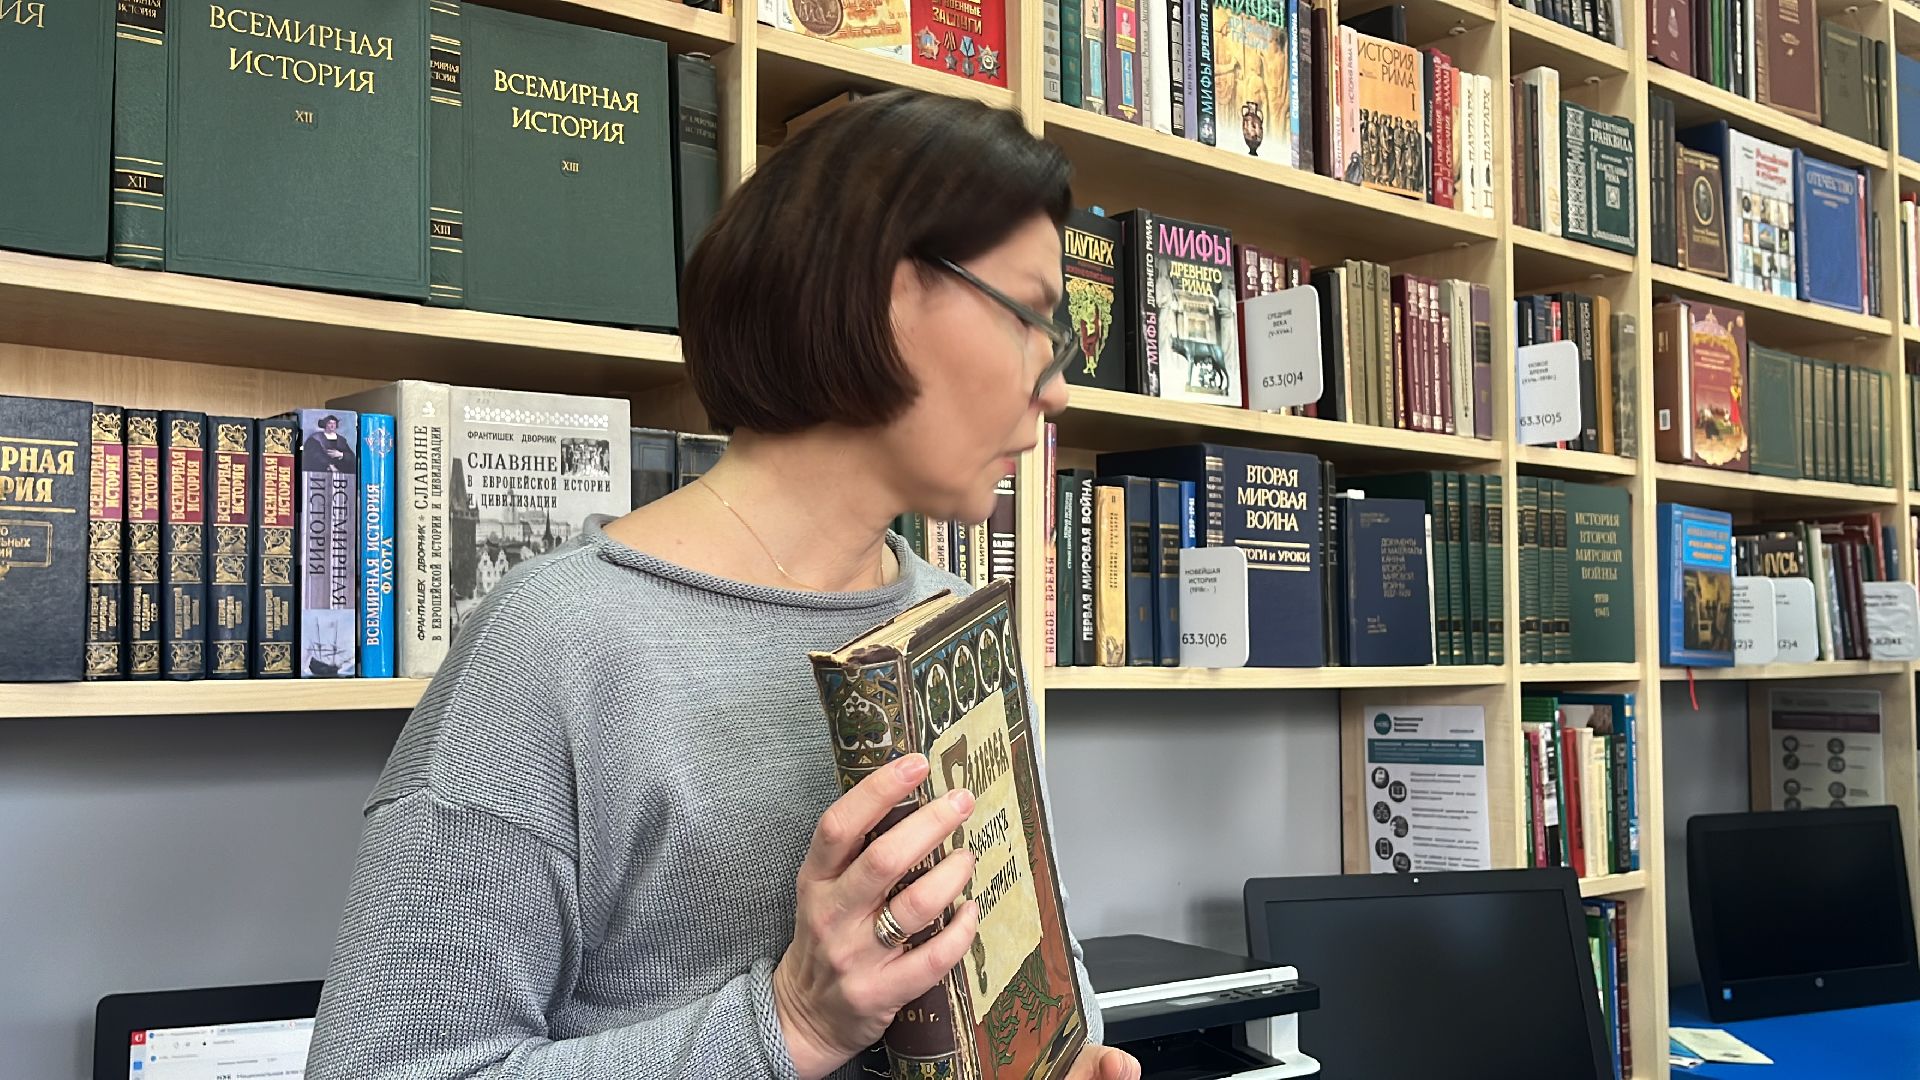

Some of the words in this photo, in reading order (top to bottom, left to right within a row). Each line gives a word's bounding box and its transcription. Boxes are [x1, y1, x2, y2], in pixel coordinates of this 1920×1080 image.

[209, 5, 394, 61] ВСЕМИРНАЯ
[932, 6, 982, 35] ЗАСЛУГИ
[1199, 14, 1211, 61] ДРЕВНЕЙ
[229, 47, 376, 94] ИСТОРИЯ
[1357, 39, 1414, 71] ИСТОРИЯ
[494, 69, 640, 114] ВСЕМИРНАЯ
[1200, 62, 1213, 115] МИФЫ
[1381, 64, 1416, 91] РИМА
[512, 107, 625, 145] ИСТОРИЯ
[127, 175, 148, 189] XII
[432, 223, 451, 236] XIII
[1064, 229, 1115, 266] ПЛУТАРХ
[1145, 219, 1153, 251] РИМА
[1159, 223, 1232, 267] МИФЫ
[1147, 253, 1155, 307] ДРЕВНЕГО
[1169, 261, 1223, 283] ДРЕВНЕГО
[1182, 277, 1214, 296] РИМА
[1146, 311, 1158, 365] МИФЫ
[1262, 371, 1304, 388] 63.3(0)4
[467, 431, 514, 442] ФРАНТИШЕК
[521, 433, 557, 445] ДВОРНИК
[0, 446, 75, 476] РНАЯ
[90, 446, 104, 518] ВСЕМИРНАЯ
[104, 454, 120, 508] ИСТОРИЯ
[414, 425, 428, 510] СЛАВЯНЕ
[431, 426, 442, 498] ЦИВИЛИЗАЦИИ
[467, 452, 558, 473] СЛАВЯНЕ
[1246, 464, 1298, 488] ВТОРАЯ
[128, 450, 142, 519] ВСЕМИРНАЯ
[144, 457, 158, 510] ИСТОРИЯ
[172, 452, 186, 520] ВСЕМИРНАЯ
[187, 460, 200, 512] ИСТОРИЯ
[217, 455, 232, 523] ВСЕМИРНАЯ
[232, 463, 245, 515] ИСТОРИЯ
[264, 457, 277, 524] ВСЕМИРНАЯ
[278, 465, 291, 516] ИСТОРИЯ
[467, 475, 473, 487] В
[482, 474, 558, 490] ЕВРОПЕЙСКОЙ
[564, 478, 612, 493] ИСТОРИИ
[481, 495, 558, 509] ЦИВИЛИЗАЦИИ
[1079, 478, 1093, 525] ВОЙНА
[1237, 487, 1308, 511] МИРОВАЯ
[309, 476, 325, 577] ИСТОРИЯ
[366, 483, 380, 547] ИСТОРИЯ
[432, 515, 442, 559] ИСТОРИИ
[1246, 509, 1300, 532] ВОЙНА
[1575, 512, 1620, 528] ИСТОРИЯ
[1580, 530, 1617, 544] ВТОРОЙ
[332, 477, 347, 607] ВСЕМИРНАЯ
[417, 524, 426, 574] ДВОРНИК
[1081, 527, 1092, 590] МИРОВАЯ
[1278, 549, 1311, 564] УРОКИ
[1575, 548, 1622, 563] МИРОВОЙ
[381, 536, 393, 595] ФЛОТА
[1184, 567, 1221, 576] НОВЕЙШАЯ
[1188, 576, 1217, 585] ИСТОРИЯ
[1581, 566, 1618, 580] ВОЙНЫ
[366, 551, 380, 647] ВСЕМИРНАЯ
[417, 579, 426, 641] ФРАНТИШЕК
[432, 563, 442, 631] ЕВРОПЕЙСКОЙ
[1082, 594, 1093, 641] ПЕРВАЯ
[1045, 610, 1054, 653] НОВОЕ
[1181, 632, 1228, 648] 63.3(0)6
